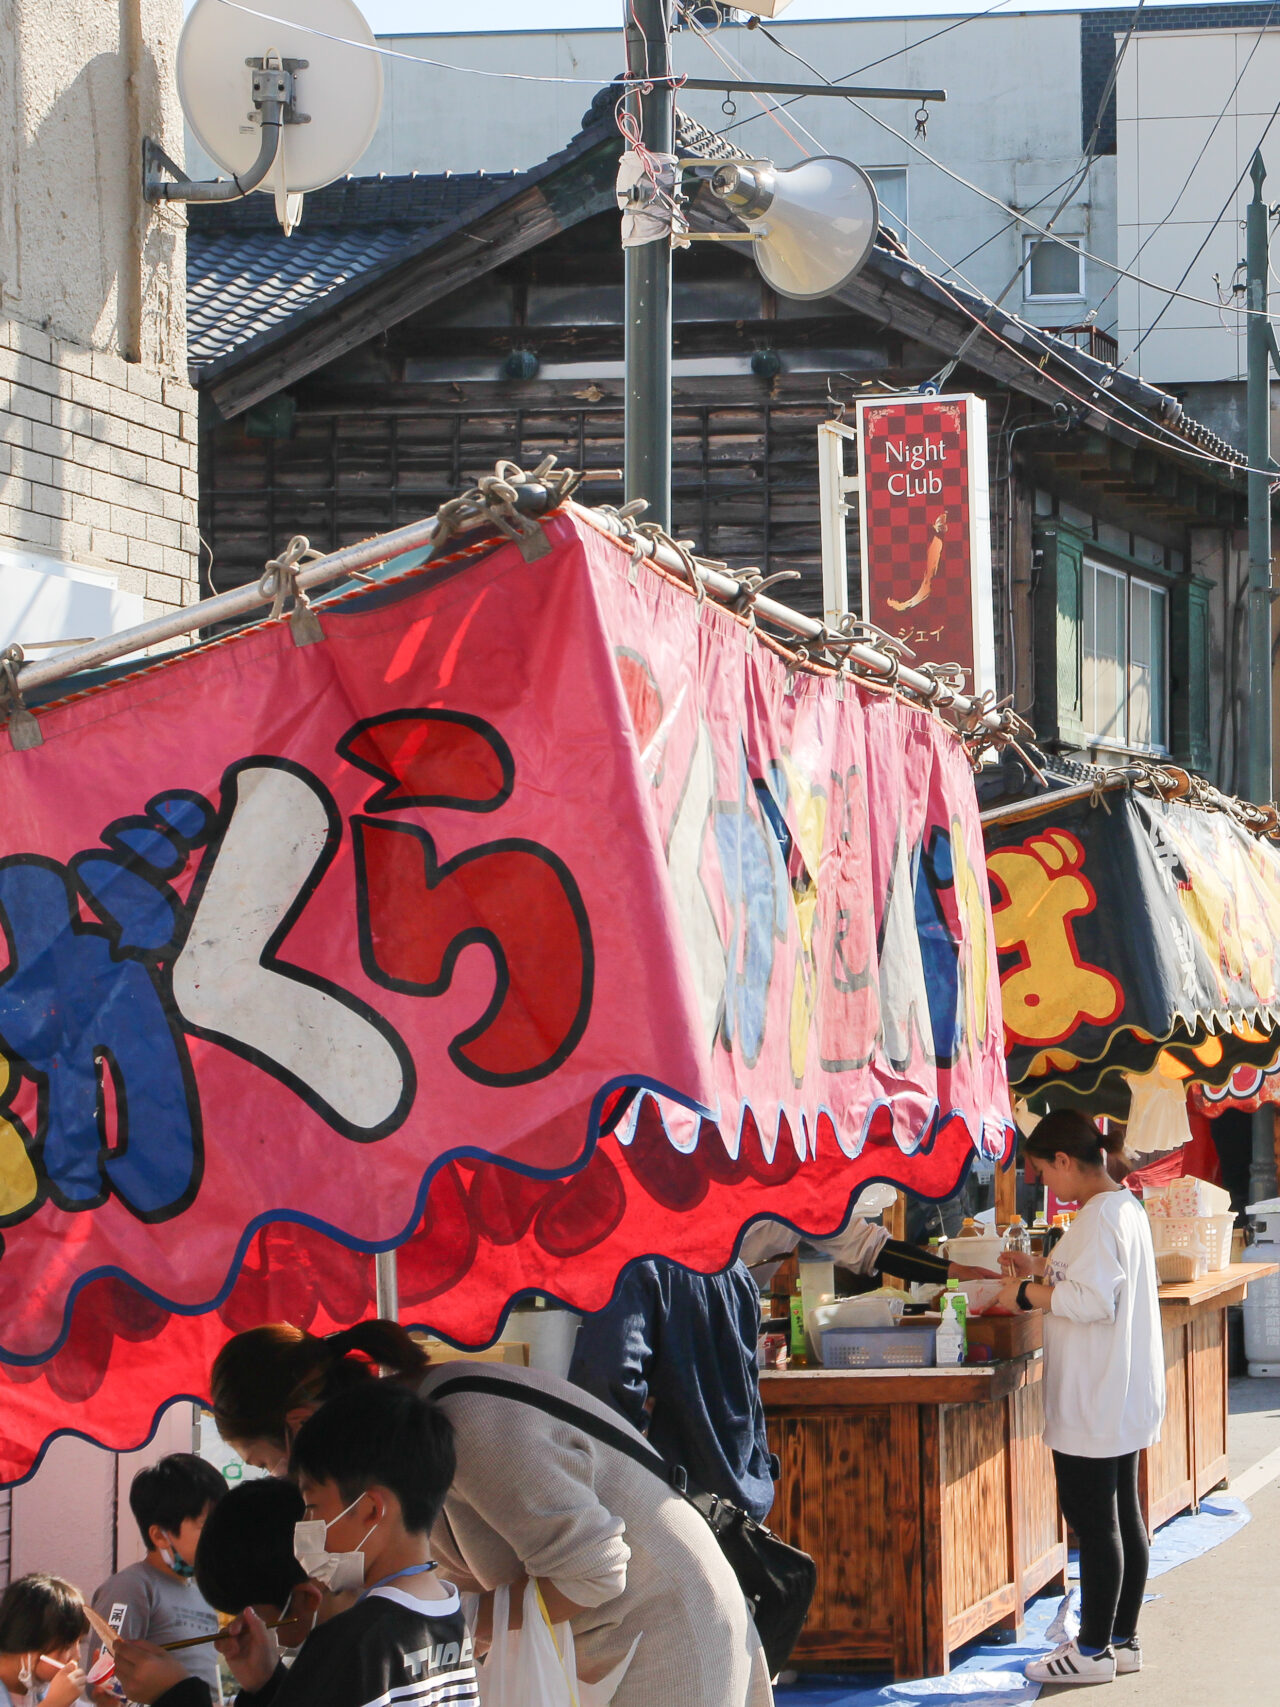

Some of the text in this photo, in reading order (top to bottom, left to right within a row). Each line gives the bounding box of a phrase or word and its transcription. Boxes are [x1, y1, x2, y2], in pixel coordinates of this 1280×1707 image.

[885, 437, 947, 470] Night
[898, 626, 944, 643] ジェイ
